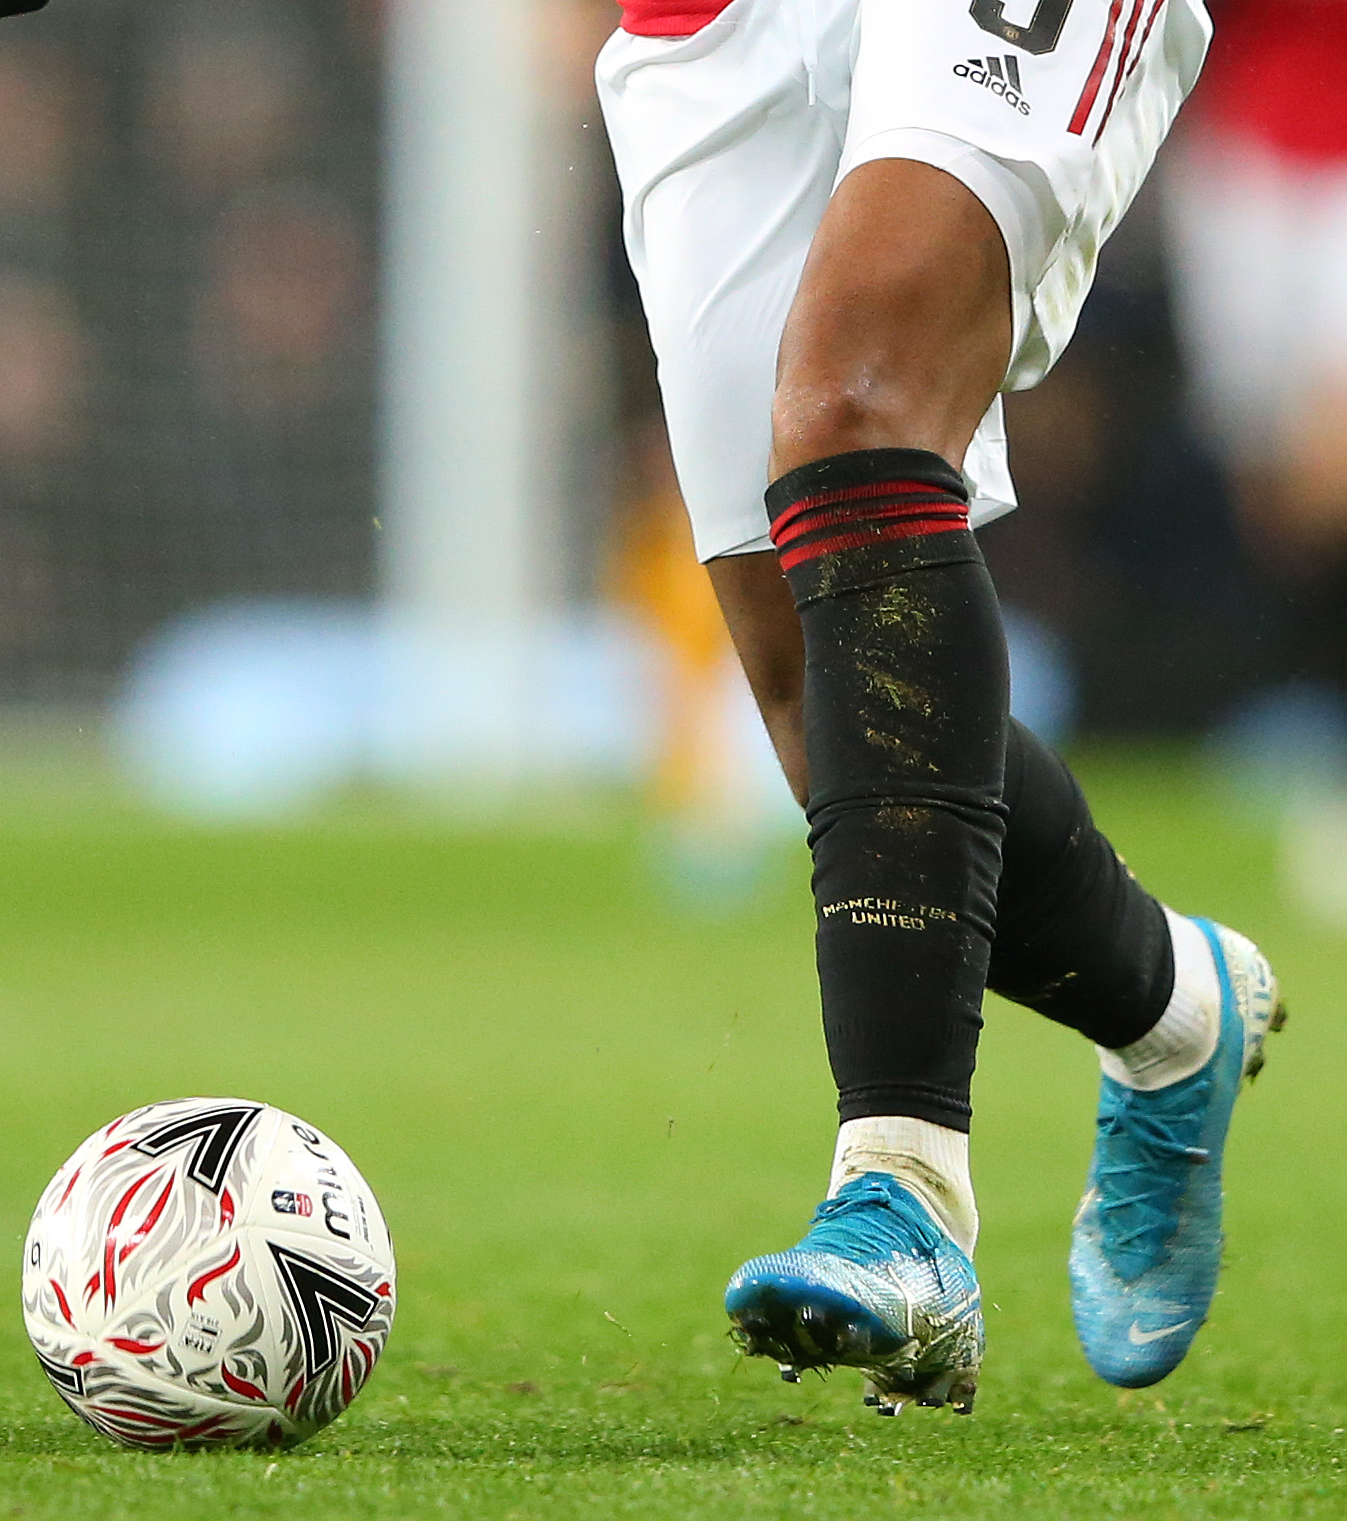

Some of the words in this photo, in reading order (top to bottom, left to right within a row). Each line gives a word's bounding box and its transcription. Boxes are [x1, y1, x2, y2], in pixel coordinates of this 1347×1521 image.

[953, 62, 1031, 117] adidas
[822, 897, 958, 922] MANCHETER
[851, 911, 926, 931] UNITED
